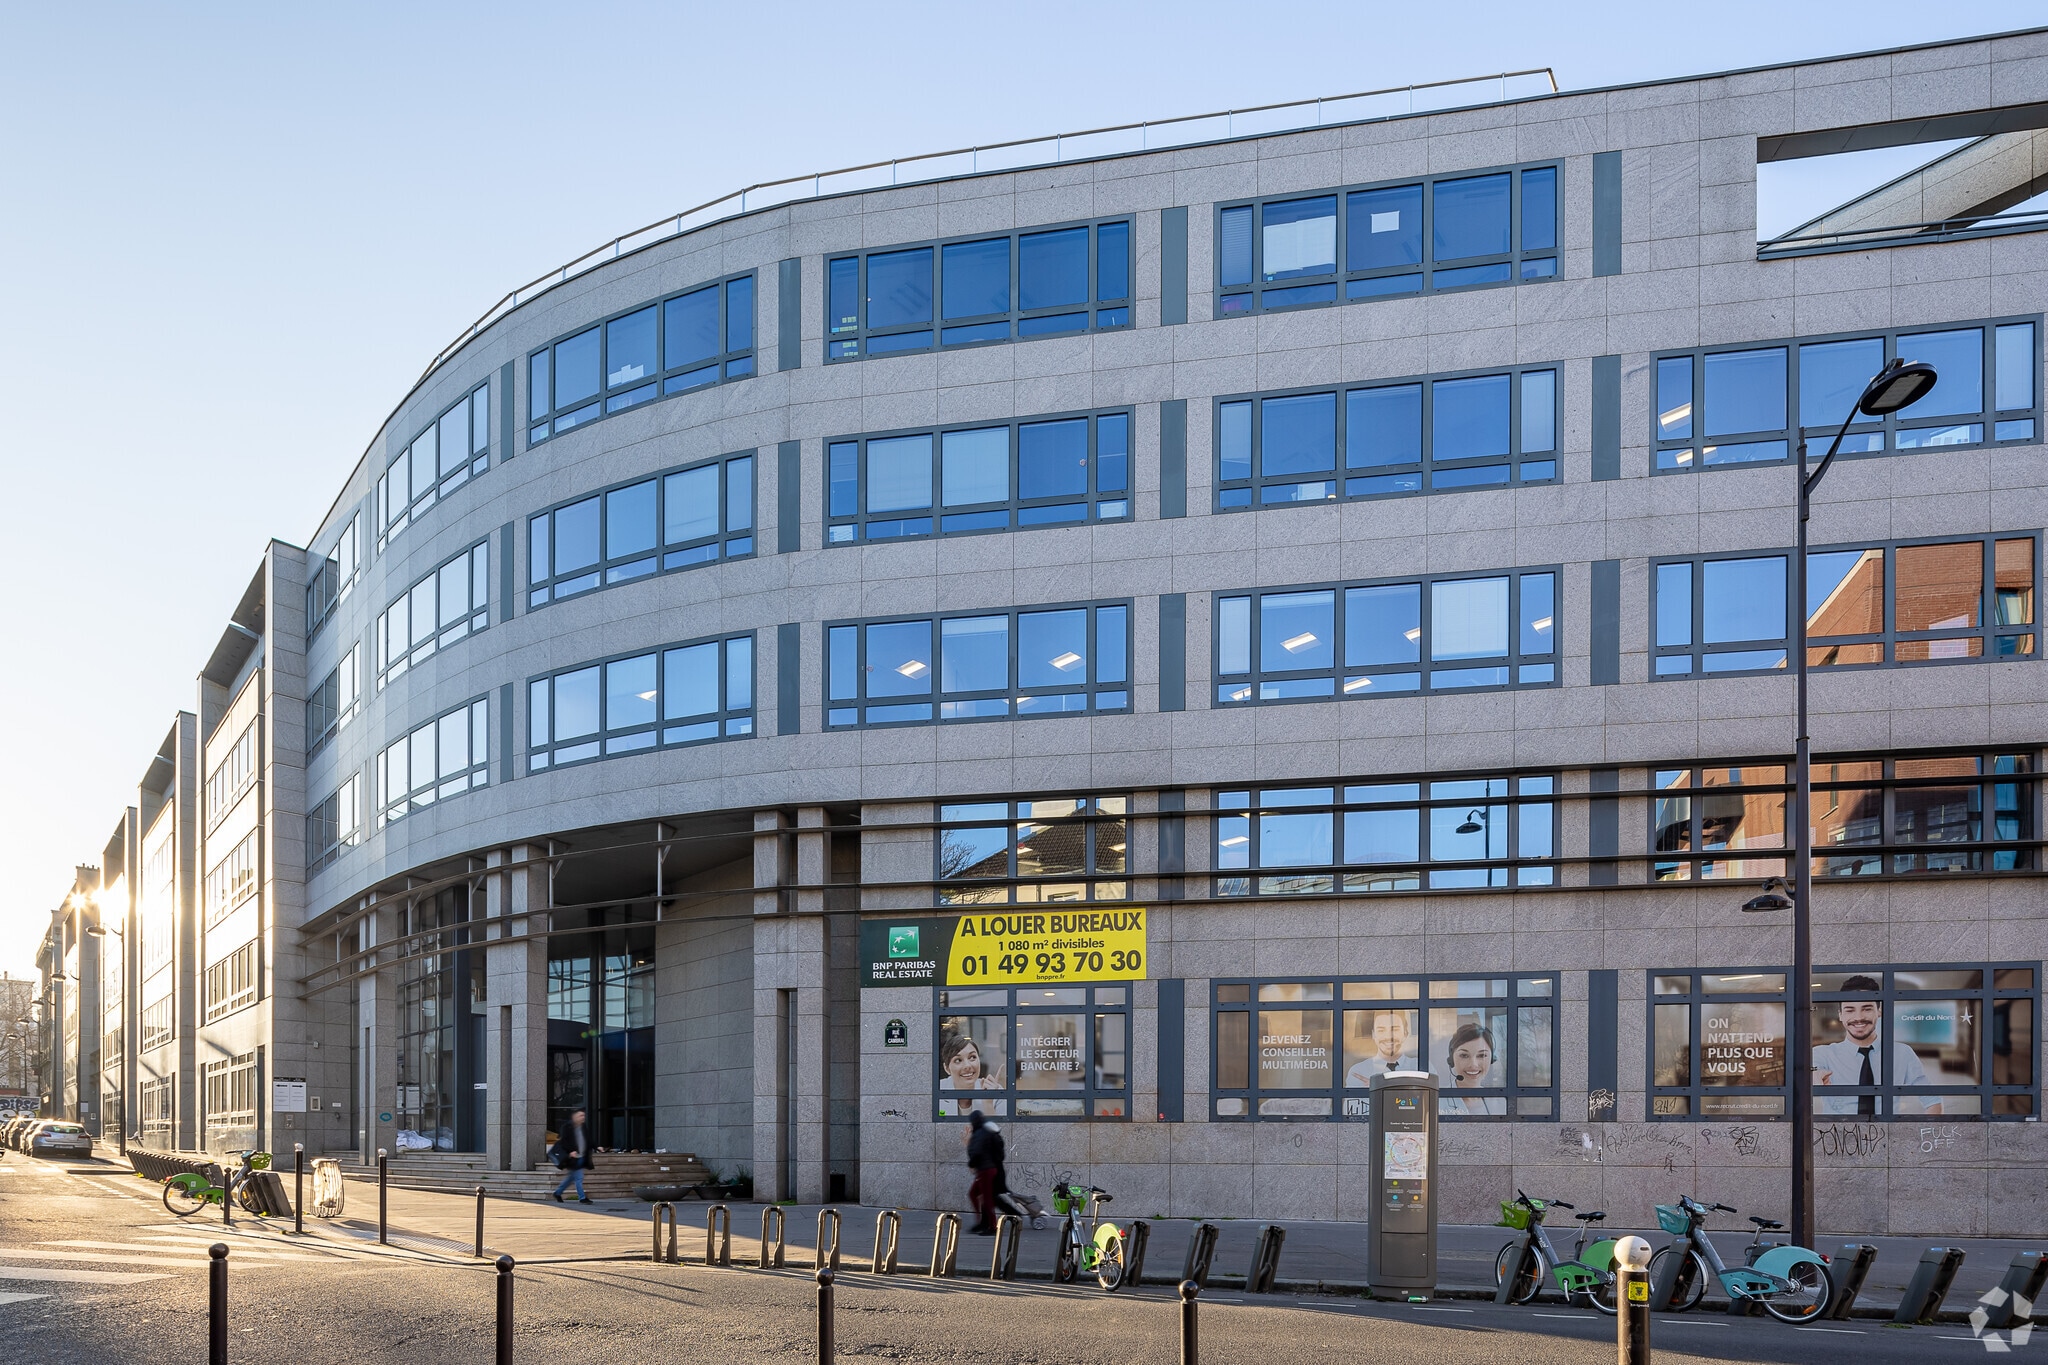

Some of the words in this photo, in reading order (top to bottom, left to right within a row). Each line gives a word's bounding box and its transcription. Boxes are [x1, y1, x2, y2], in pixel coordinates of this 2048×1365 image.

[961, 918, 976, 937] A
[981, 915, 1046, 936] LOUER
[1051, 911, 1142, 934] BUREAUX
[999, 941, 1003, 951] 1
[1008, 940, 1030, 951] 080
[1033, 939, 1049, 950] m²
[1052, 938, 1105, 949] divisibles
[872, 962, 893, 970] BNP
[894, 960, 936, 969] PARIBAS
[962, 955, 988, 976] 01
[998, 953, 1029, 974] 49
[1035, 953, 1066, 973] 93
[1073, 951, 1103, 972] 70
[1110, 950, 1142, 971] 30
[872, 971, 897, 979] REAL
[898, 970, 933, 978] ESTATE
[1708, 1018, 1729, 1029] ON
[1020, 1036, 1071, 1047] INTÉGRER
[1262, 1035, 1311, 1045] DEVENEZ
[1020, 1050, 1032, 1059] LE
[1034, 1049, 1079, 1059] SECTEUR
[1262, 1047, 1326, 1057] CONSEILLER
[1708, 1047, 1742, 1059] PLUS
[1744, 1047, 1774, 1060] QUE
[1020, 1061, 1073, 1071] BANCAIRE
[1074, 1061, 1080, 1071] ?
[1262, 1059, 1329, 1069] MULTIMÉDIA
[1707, 1062, 1746, 1073] VOUS
[1920, 1125, 1962, 1141] FUCK
[1920, 1138, 1955, 1152] OFF
